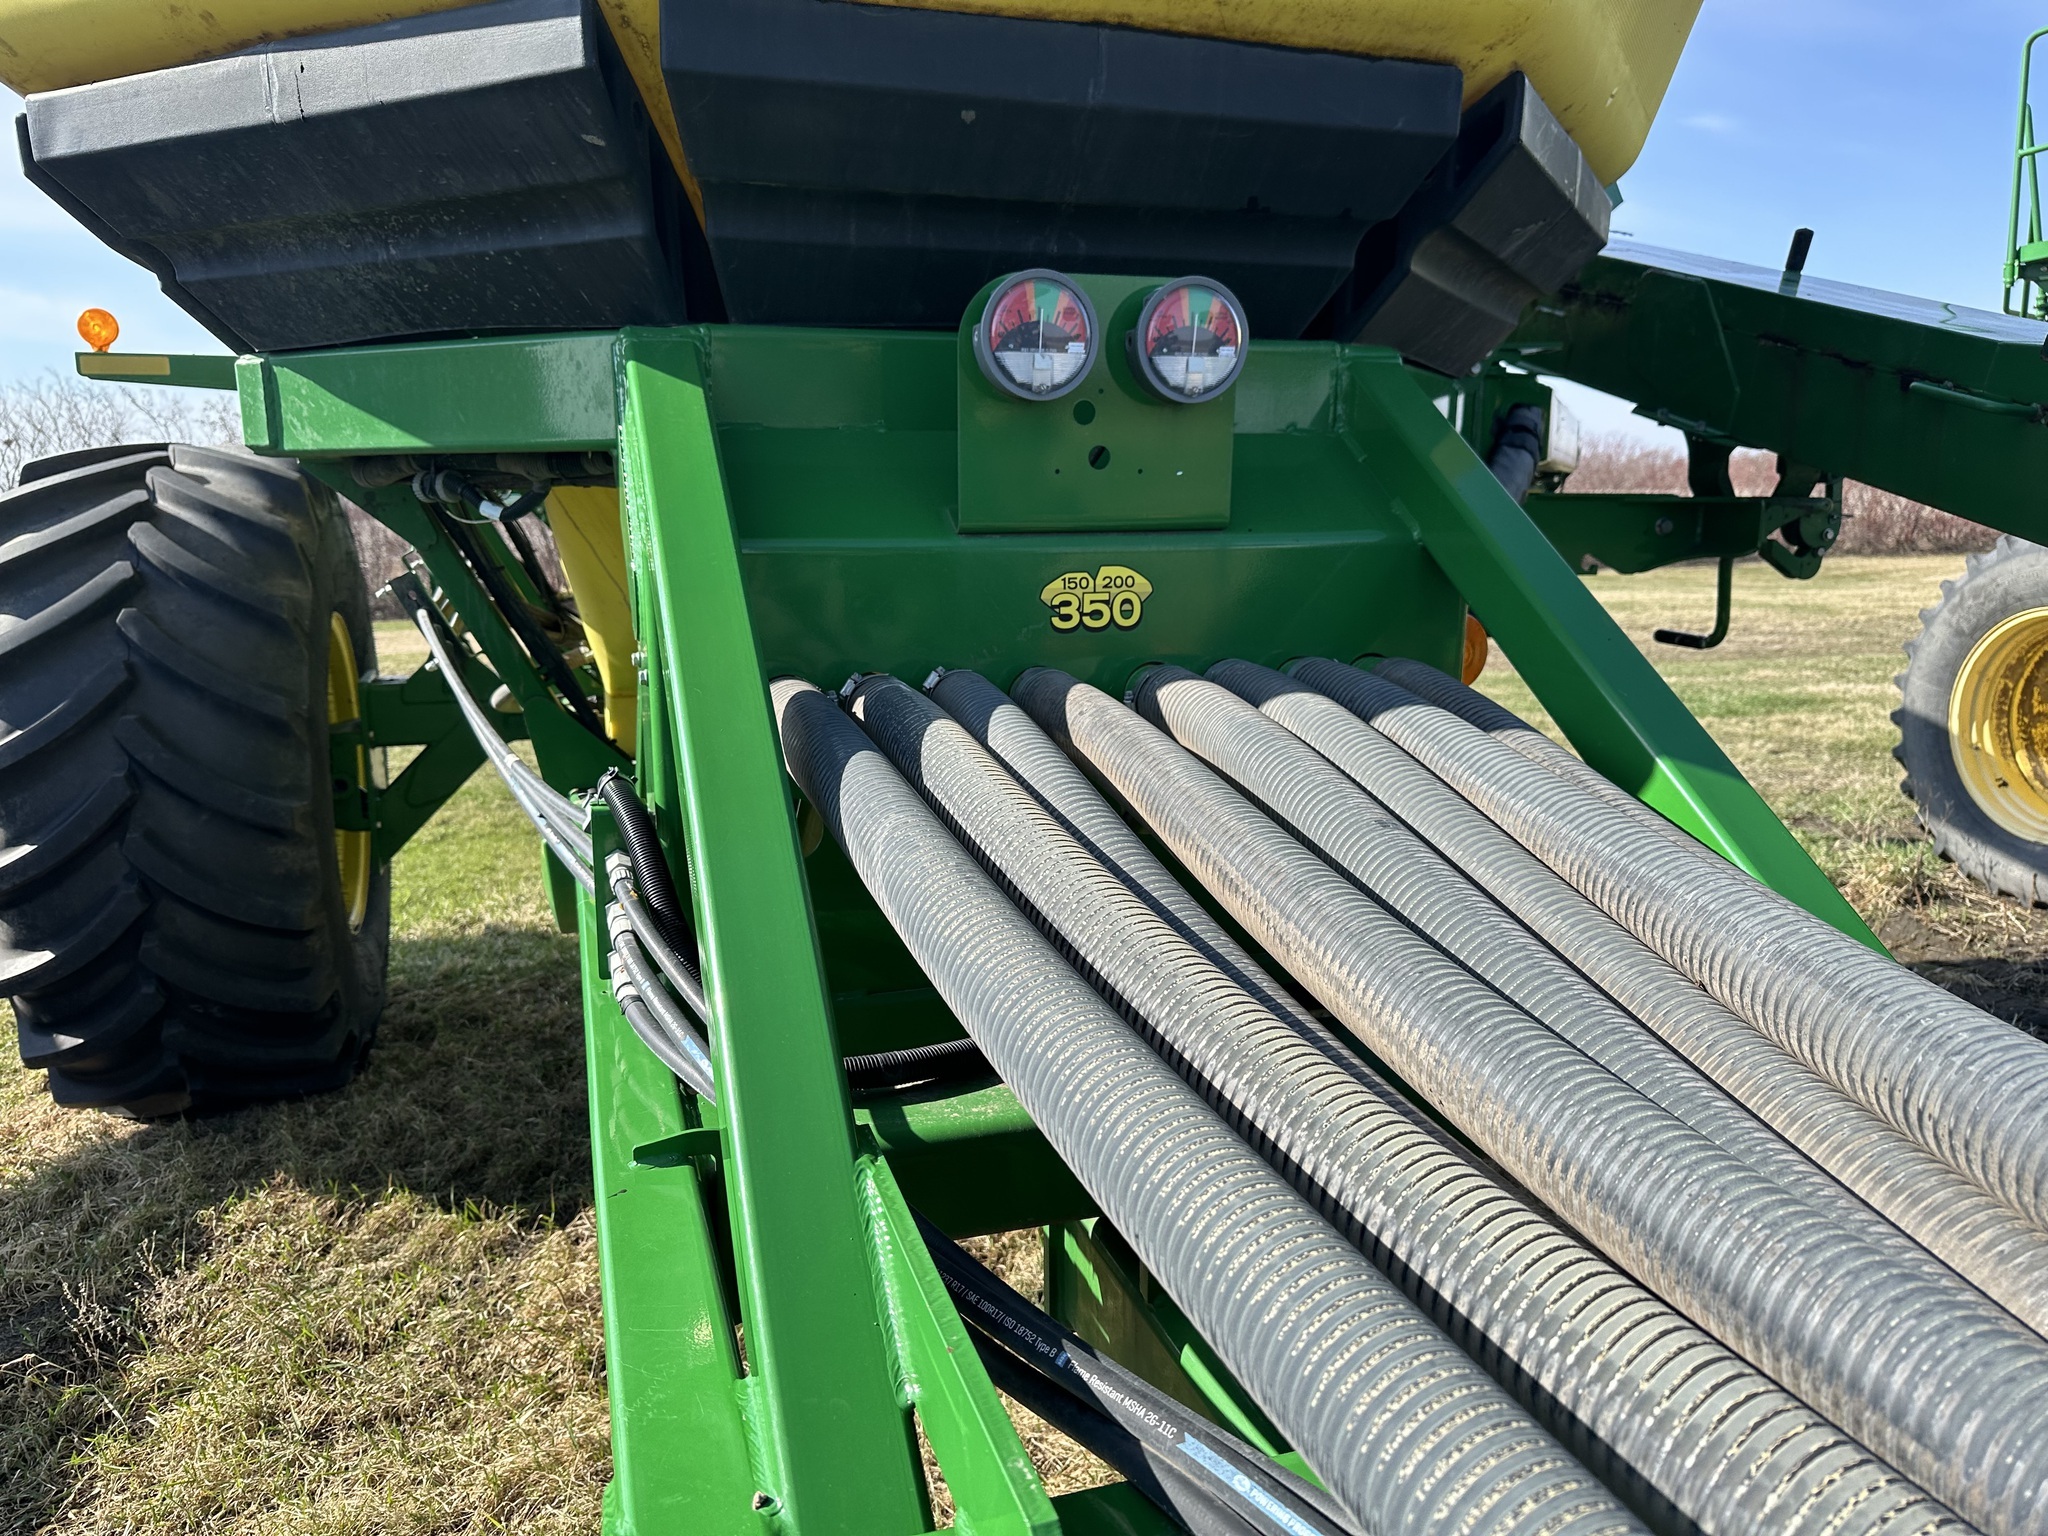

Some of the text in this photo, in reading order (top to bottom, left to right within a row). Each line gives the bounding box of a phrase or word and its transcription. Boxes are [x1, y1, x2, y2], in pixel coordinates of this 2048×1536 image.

[1061, 575, 1135, 590] 150 200
[1050, 590, 1142, 632] 350
[950, 1280, 966, 1294] R17
[965, 1290, 980, 1305] SAE
[1002, 1315, 1017, 1330] ISO
[1013, 1323, 1037, 1344] 18752
[1034, 1337, 1051, 1354] Type
[1048, 1348, 1058, 1358] B
[1067, 1360, 1089, 1381] Flame
[1088, 1374, 1124, 1404] Resistant
[1122, 1396, 1146, 1419] MSHA
[1143, 1411, 1178, 1439] 2G-11C
